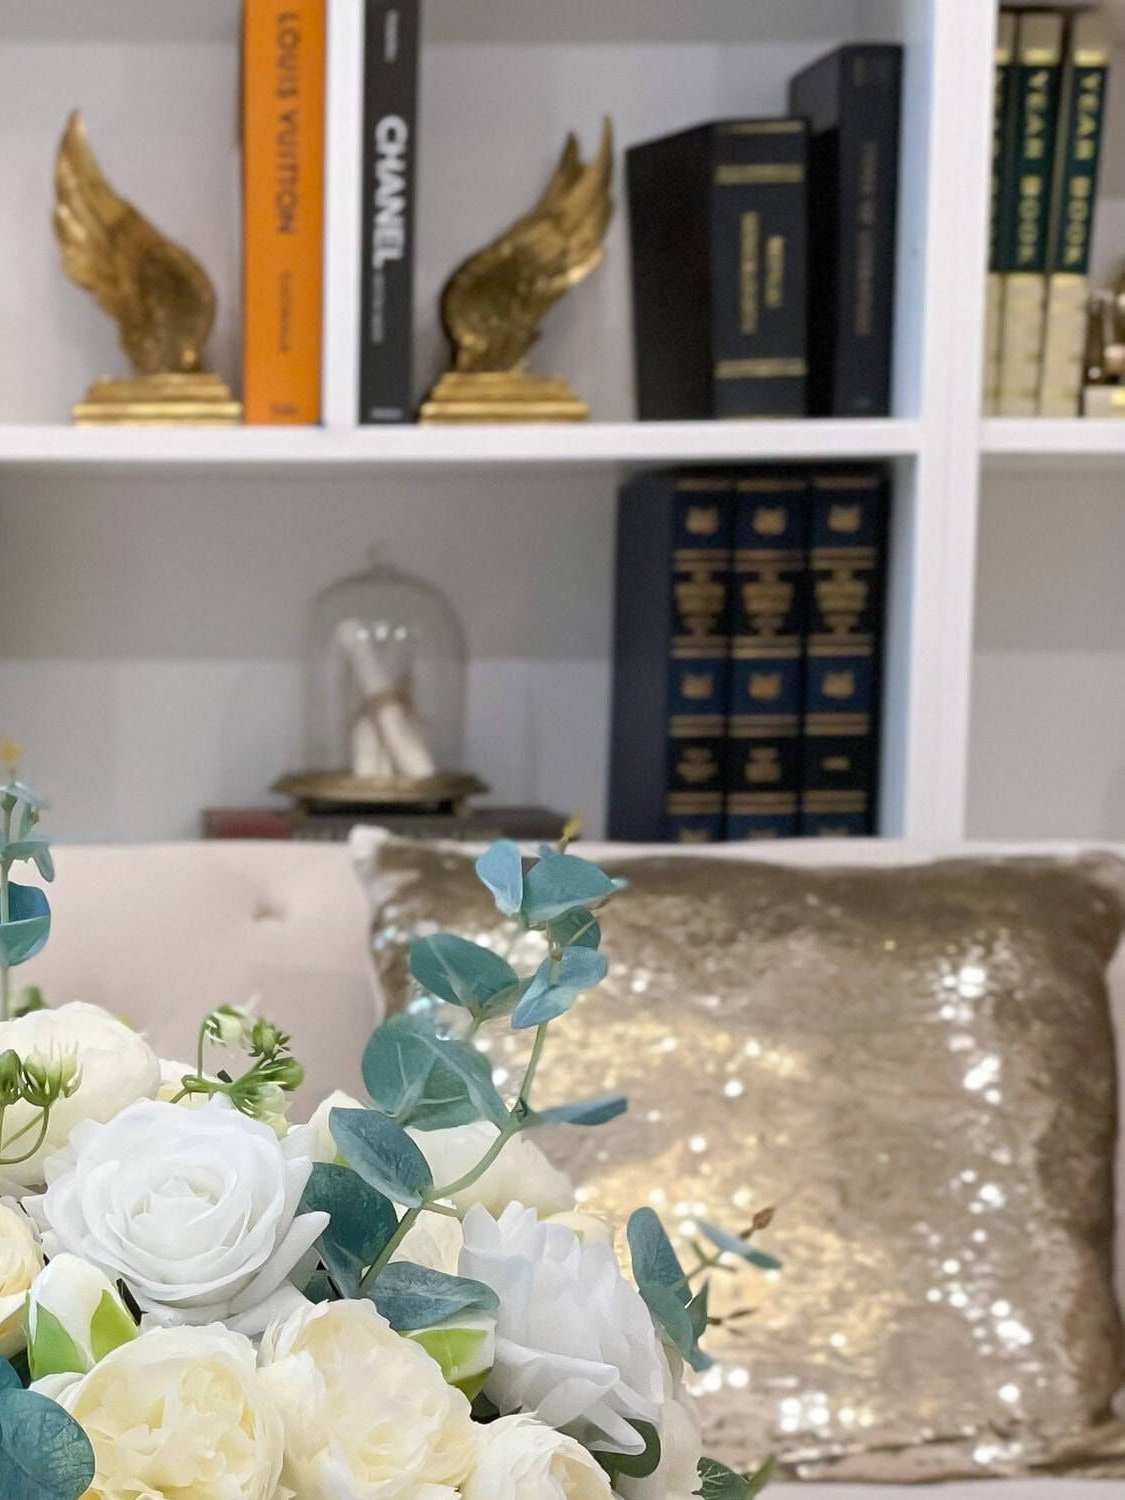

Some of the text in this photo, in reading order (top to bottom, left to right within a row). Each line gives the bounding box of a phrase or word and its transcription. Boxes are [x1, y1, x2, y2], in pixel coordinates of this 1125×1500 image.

[275, 12, 301, 236] LOUIS VUITTON
[374, 115, 409, 269] CHANEL
